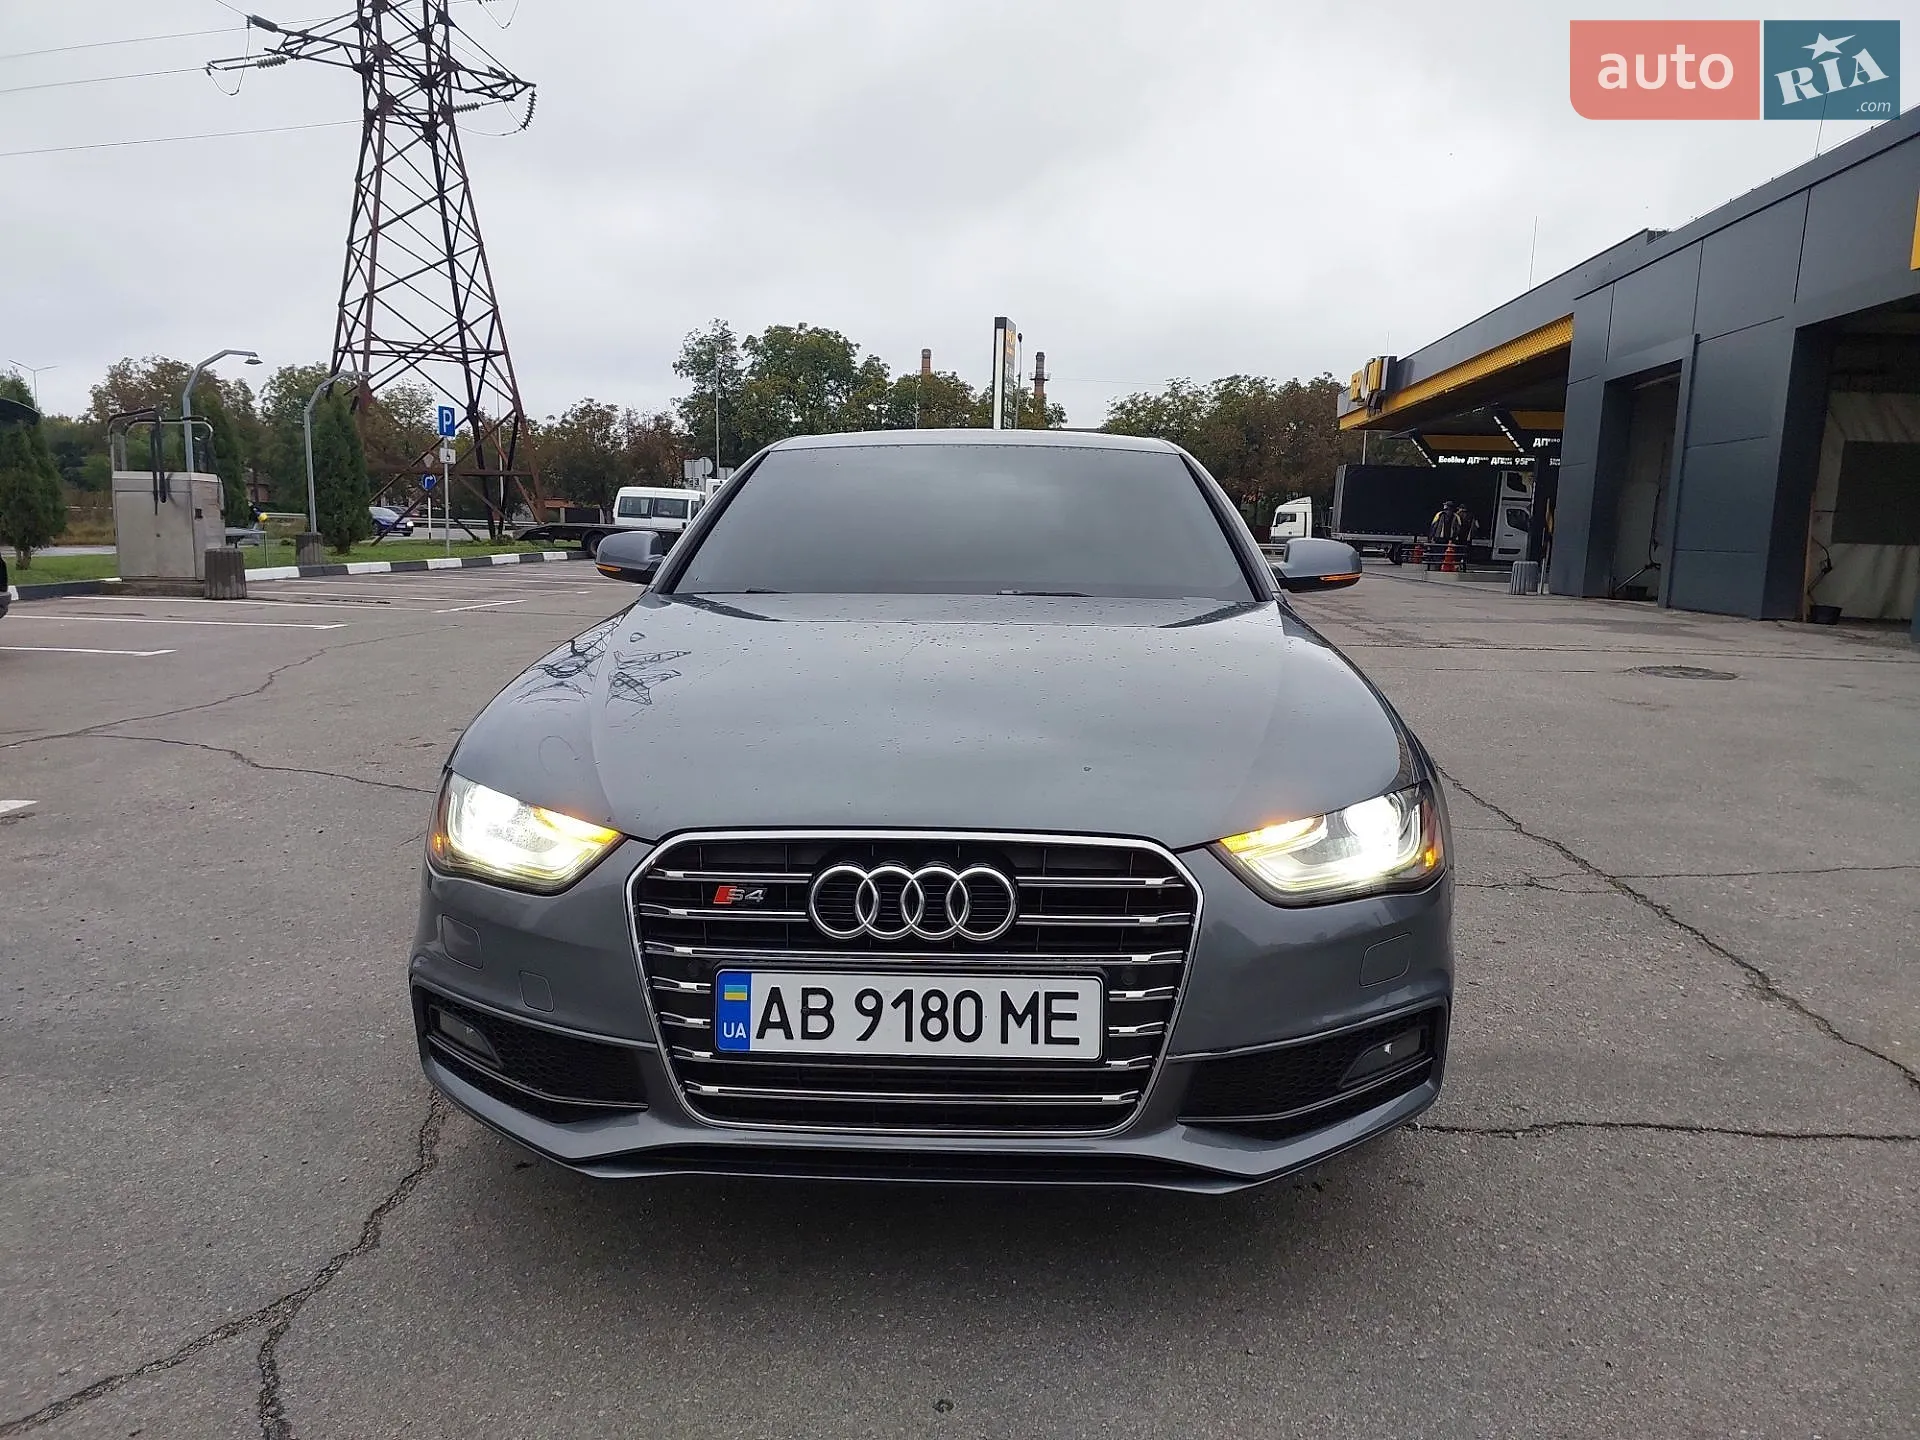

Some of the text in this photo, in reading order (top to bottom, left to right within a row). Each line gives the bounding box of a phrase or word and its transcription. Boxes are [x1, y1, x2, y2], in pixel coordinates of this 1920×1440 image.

[443, 410, 452, 432] P
[725, 888, 764, 903] S4
[755, 986, 1080, 1045] AB 9180 ME
[723, 1022, 746, 1039] UA
